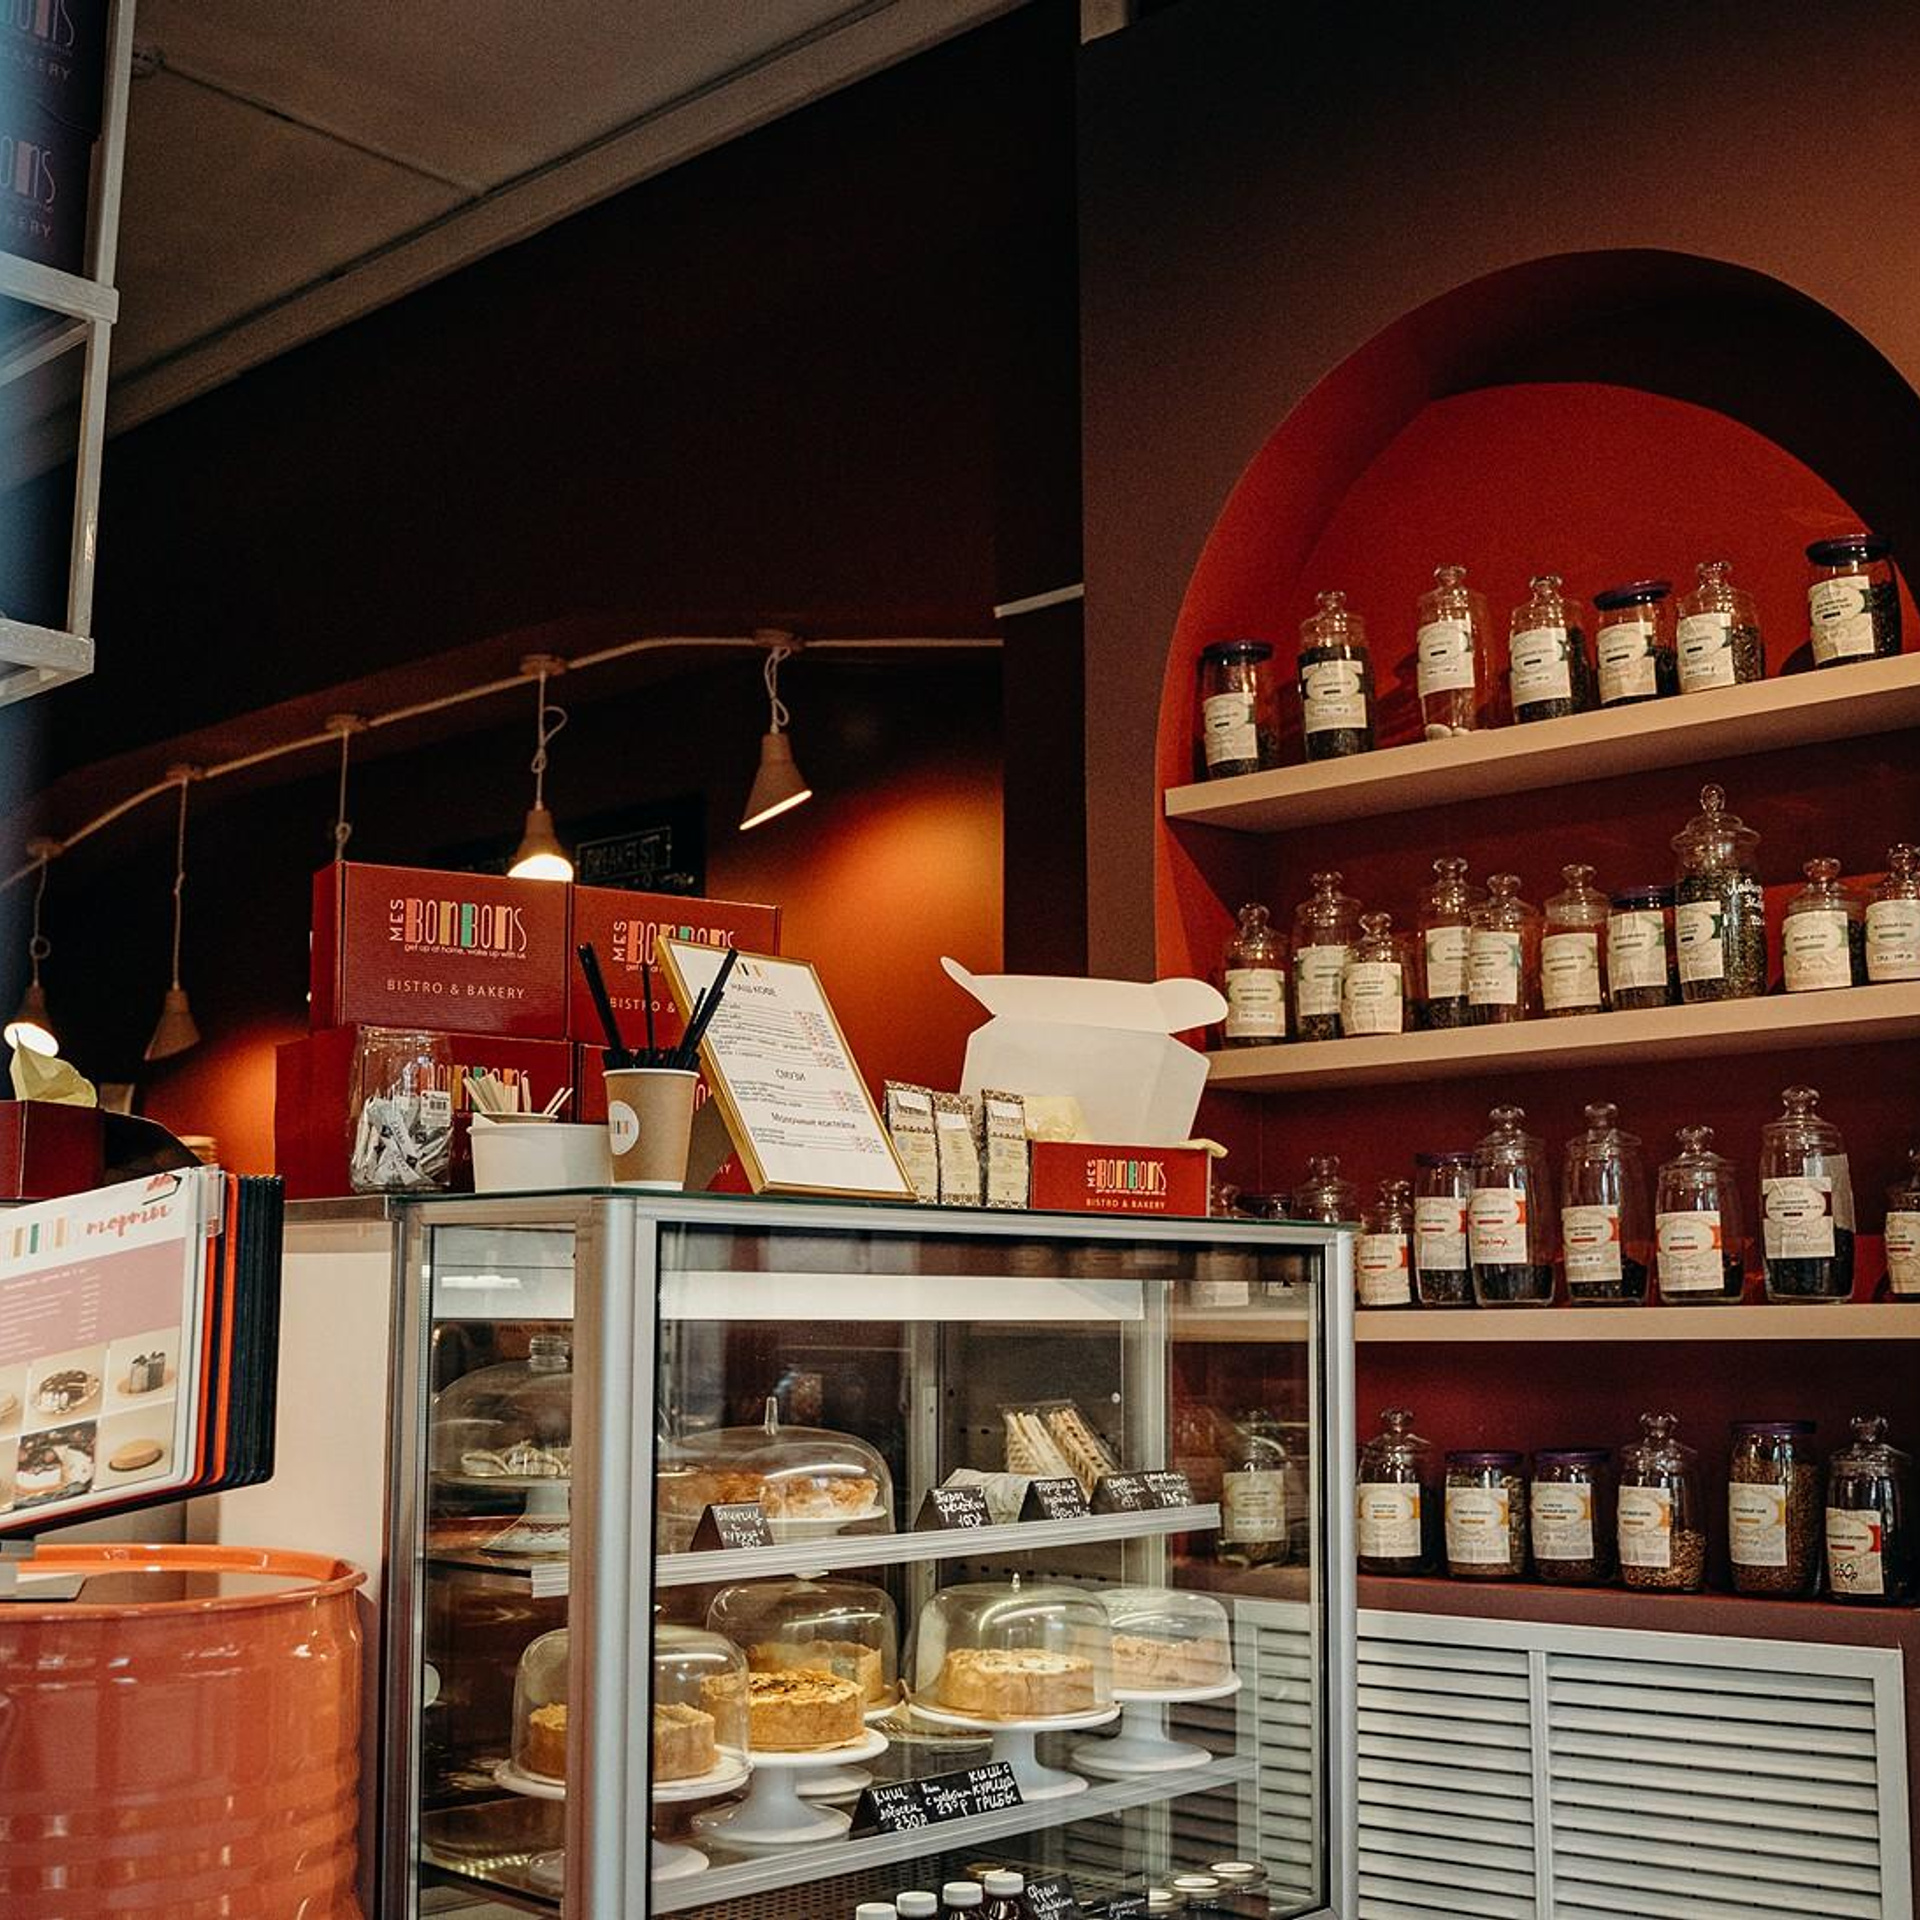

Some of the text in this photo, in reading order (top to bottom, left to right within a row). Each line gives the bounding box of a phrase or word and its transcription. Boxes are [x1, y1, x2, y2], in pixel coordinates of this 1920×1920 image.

[389, 899, 404, 941] MES
[612, 920, 627, 962] MES
[386, 980, 525, 999] BISTRO & BAKERY
[666, 1001, 676, 1013] &
[1131, 1200, 1165, 1209] BAKERY
